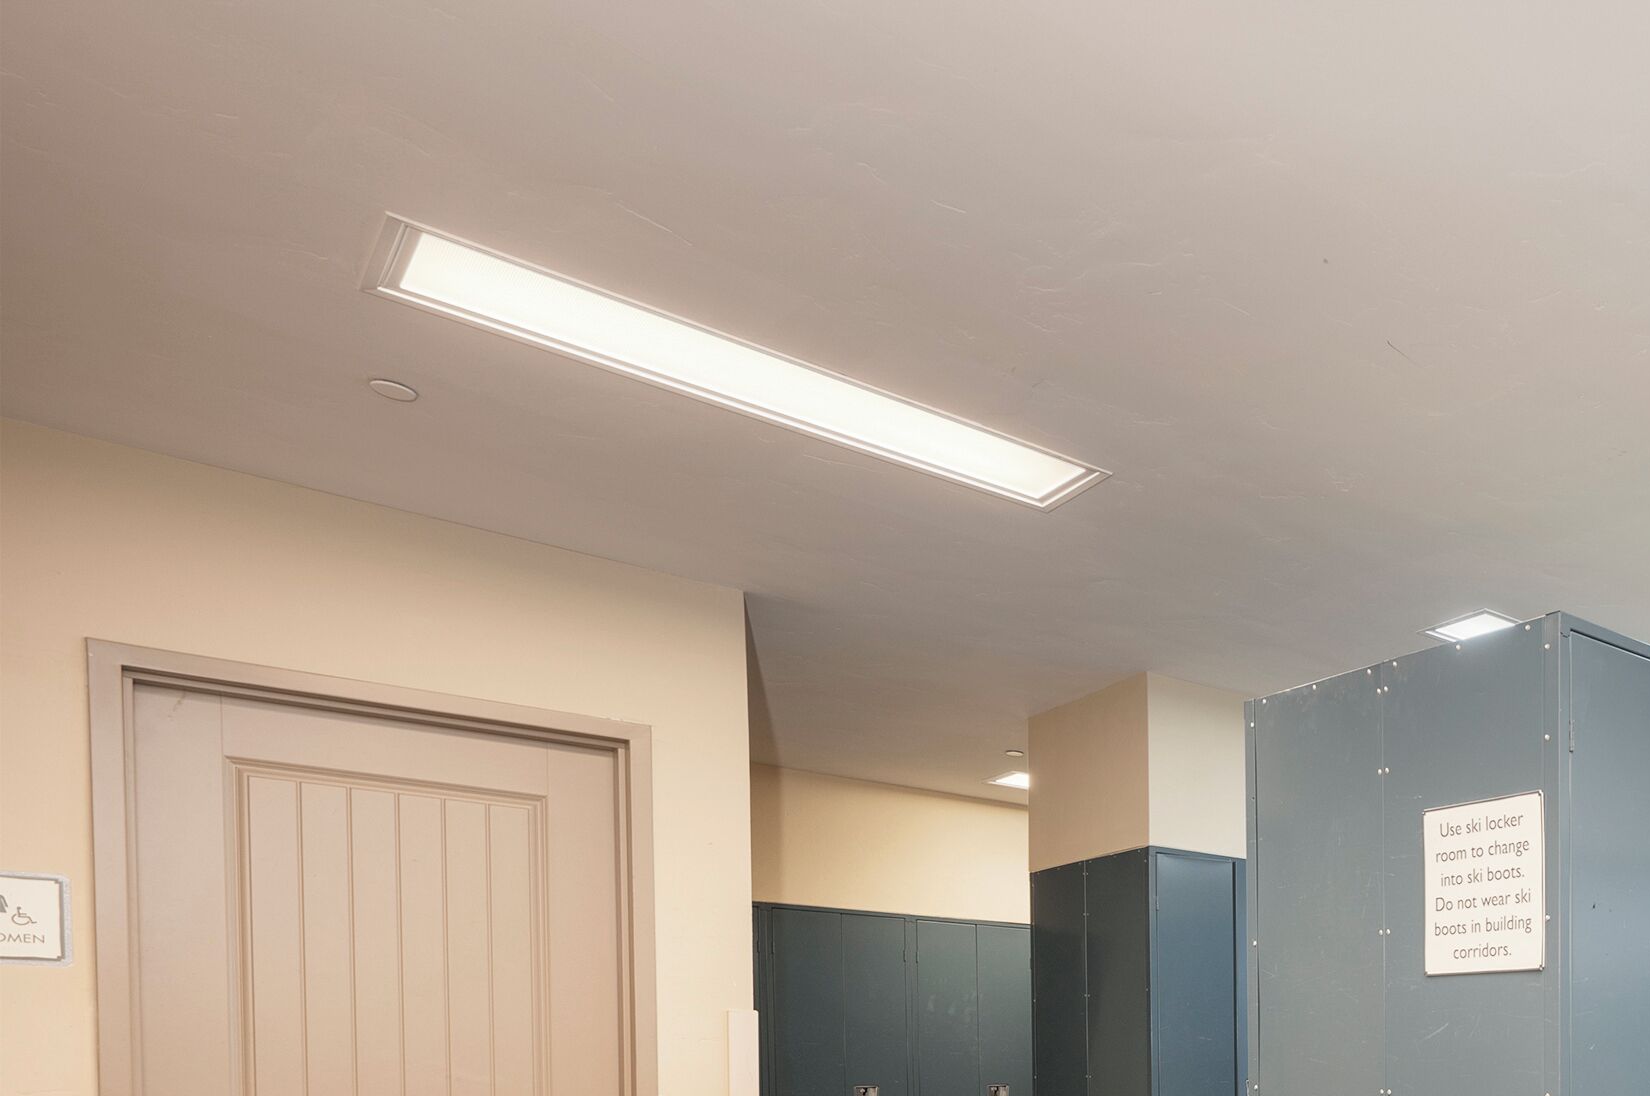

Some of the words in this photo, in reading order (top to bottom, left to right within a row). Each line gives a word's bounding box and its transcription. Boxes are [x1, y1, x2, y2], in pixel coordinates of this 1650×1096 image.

[1440, 822, 1462, 838] Use
[1466, 818, 1481, 834] ski
[1486, 814, 1523, 831] locker
[1436, 850, 1466, 862] room
[1471, 846, 1484, 857] to
[1488, 840, 1529, 857] change
[1441, 873, 1462, 887] into
[1468, 868, 1483, 884] ski
[1487, 866, 1524, 881] boots.
[1436, 897, 1453, 912] Do
[1458, 895, 1476, 909] not
[1481, 894, 1510, 906] wear
[1515, 889, 1531, 904] ski
[1435, 921, 1466, 936] boots
[1472, 920, 1480, 933] in
[1486, 916, 1532, 933] building
[1453, 943, 1511, 959] corridors.
